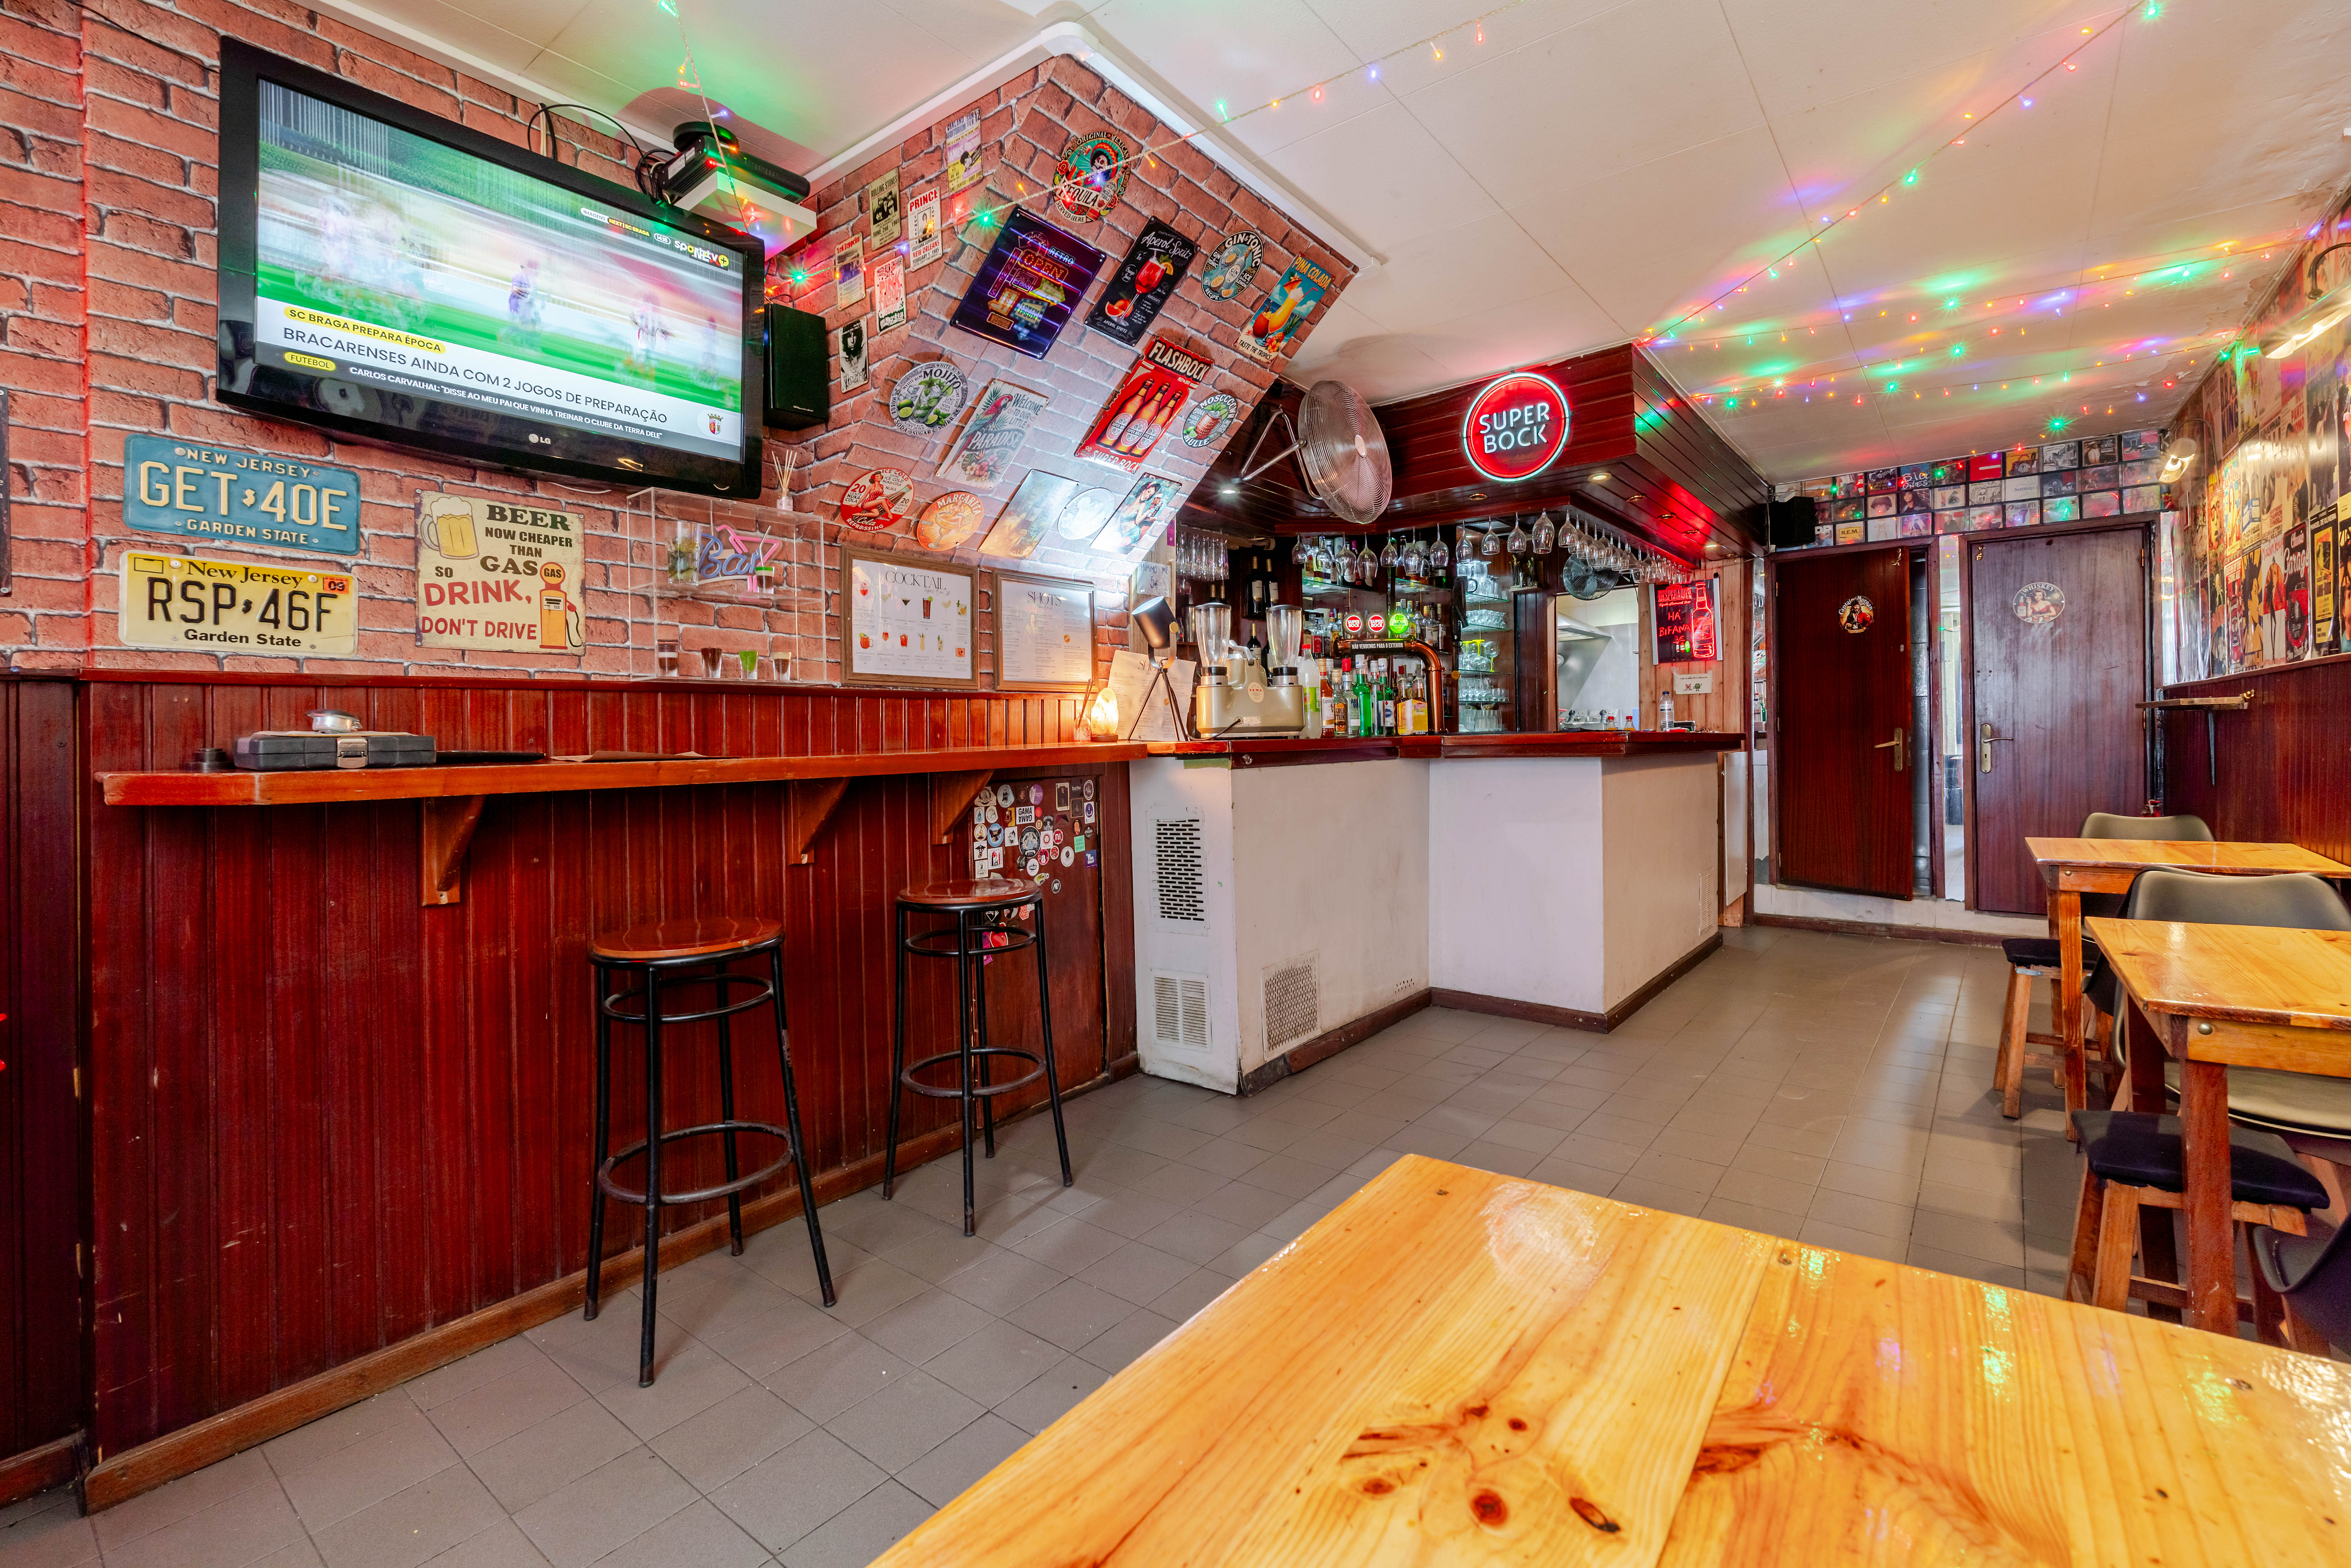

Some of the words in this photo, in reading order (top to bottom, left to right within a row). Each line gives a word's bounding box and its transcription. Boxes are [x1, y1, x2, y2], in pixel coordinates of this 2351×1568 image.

[1077, 133, 1107, 145] ORIGINAL
[1111, 134, 1130, 159] MEXICAN
[871, 183, 884, 198] ROLLING
[885, 175, 897, 190] STONES
[910, 189, 938, 212] PRINCE
[583, 210, 606, 221] IMAGENS
[1056, 201, 1071, 219] SERVED
[1071, 214, 1085, 222] HERE
[609, 219, 622, 227] NEXT
[632, 227, 649, 236] BRAGA
[873, 230, 881, 238] JUNE
[913, 250, 921, 258] NEW
[923, 240, 940, 253] ORLEANS
[1141, 231, 1173, 249] Aperol
[1169, 241, 1192, 259] Spritz
[913, 254, 928, 264] FEBRUARY
[1050, 248, 1074, 266] RETRO
[1208, 259, 1218, 267] TONIC
[1025, 254, 1064, 280] OPEN
[1292, 257, 1311, 275] PINA
[1307, 266, 1332, 290] COLADA
[1236, 279, 1247, 288] LEMON
[1243, 273, 1252, 281] ICE
[1205, 288, 1219, 300] RECIPE
[290, 310, 305, 319] SC
[309, 315, 350, 331] BRAGA
[352, 325, 402, 342] PREPARA
[405, 335, 441, 351] ÉPOCA
[1103, 320, 1116, 329] APEROL
[1116, 325, 1128, 333] SPRITZ
[1239, 340, 1251, 350] TASTE
[1258, 349, 1272, 360] TROPICS
[291, 355, 329, 369] FUTEBOL
[1149, 342, 1209, 381] FLASHBOCK
[284, 327, 406, 364] BRACARENSES
[411, 358, 459, 377] AINDA
[463, 370, 499, 386] COM
[503, 378, 511, 388] 2
[514, 381, 562, 399] JOGOS
[566, 393, 581, 403] DE
[585, 397, 667, 423] PREPARAÇÃO
[923, 368, 961, 389] MOJITO
[350, 367, 386, 380] CARLOS
[387, 375, 440, 392] CARVALHAL:
[441, 386, 467, 398] "DISSE
[468, 392, 480, 400] AO
[481, 395, 499, 403] MEU
[499, 399, 512, 407] PAI
[513, 402, 529, 410] QUE
[530, 406, 553, 416] VINHA
[554, 410, 583, 422] TREINAR
[591, 419, 612, 428] CLUBE
[624, 425, 645, 435] TERRA
[646, 429, 662, 438] DELE"
[1008, 418, 1027, 428] LITTLE
[1020, 411, 1031, 419] OUR
[1479, 402, 1550, 434] SUPER
[967, 431, 1023, 449] PARADISE
[1484, 424, 1547, 453] BOCK
[188, 449, 227, 464] NEW
[237, 458, 310, 478] JERSEY
[894, 469, 909, 482] COLD
[1903, 480, 1928, 489] ONES
[141, 460, 238, 516] GET
[854, 483, 866, 494] 20
[936, 494, 982, 516] MARGARITA
[487, 504, 571, 531] BEER
[857, 517, 876, 526] Cola
[188, 519, 256, 537] GARDEN
[263, 529, 308, 544] STATE
[485, 527, 516, 540] NOW
[519, 531, 572, 548] CHEAPER
[510, 544, 542, 558] THAN
[187, 561, 236, 579] New
[240, 568, 302, 588] Jersey
[435, 566, 453, 578] SO
[480, 556, 538, 576] GAS
[544, 568, 561, 578] GAS
[2283, 547, 2309, 585] Garage
[328, 581, 346, 592] 09
[885, 570, 946, 590] COCKTAIL
[1150, 576, 1158, 588] 5€
[2022, 583, 2056, 593] WHISKEY
[424, 579, 532, 606] DRINK,
[1027, 591, 1061, 606] SHOTS
[1658, 588, 1692, 601] DESPERADOS
[148, 576, 236, 625] RSP
[258, 588, 337, 632] 46F
[1857, 595, 1873, 611] Morgan
[1668, 610, 1681, 622] HÁ
[422, 616, 478, 636] DON'T
[485, 621, 537, 639] DRIVE
[1659, 623, 1691, 636] BIFANA
[184, 629, 249, 643] Garden
[257, 634, 301, 647] State
[1018, 807, 1032, 815] GAMA
